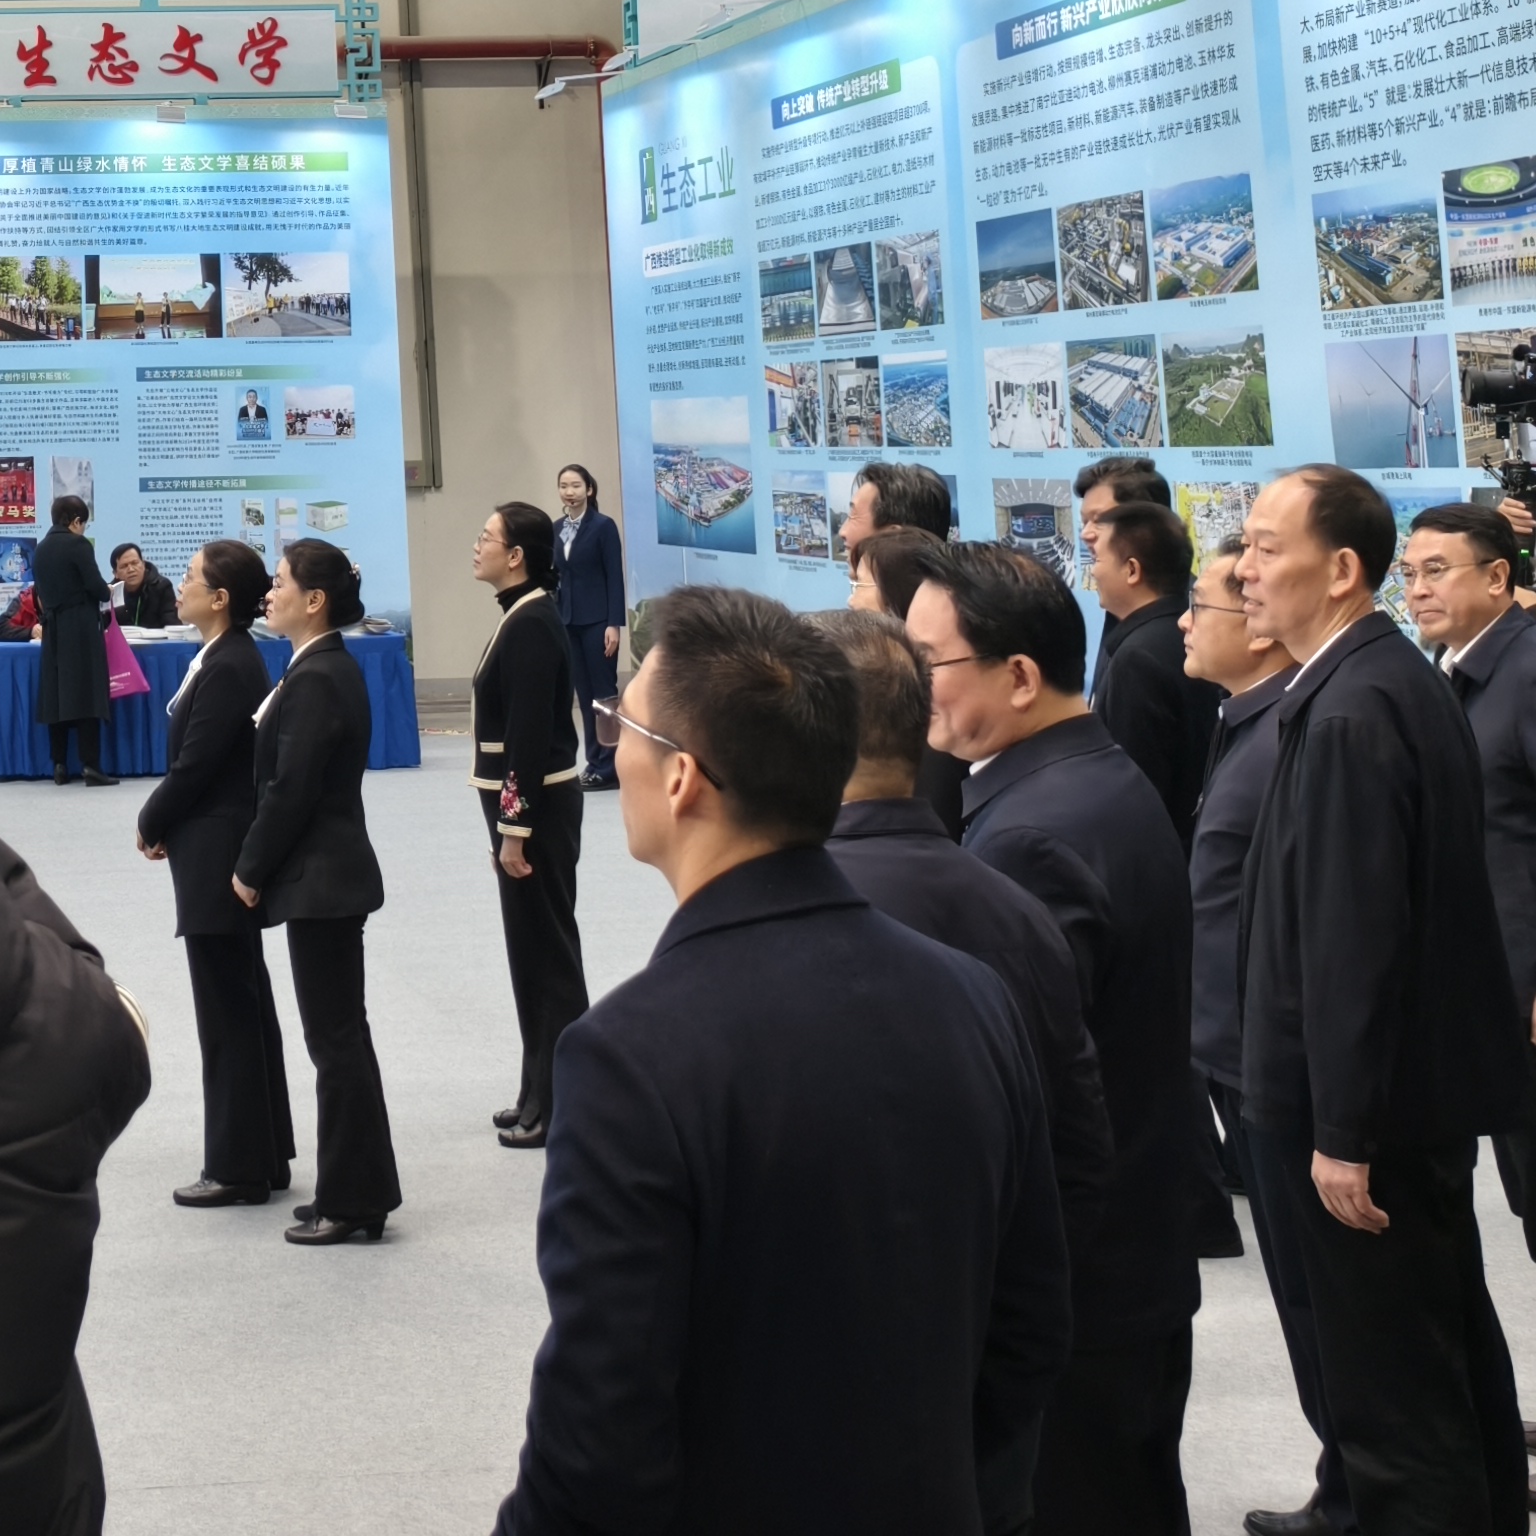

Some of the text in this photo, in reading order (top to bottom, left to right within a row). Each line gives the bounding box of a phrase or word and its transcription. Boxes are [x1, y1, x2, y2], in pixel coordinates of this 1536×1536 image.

[1011, 10, 1059, 50] 向新而行
[16, 16, 289, 87] 生态文学
[781, 69, 889, 122] 向上突破 传统产业转型升级
[2, 154, 306, 174] 厚植青山绿水情怀 生态文学喜结硕果
[660, 145, 736, 213] 生态工业
[144, 368, 243, 379] 生态文学交流活动精彩纷呈
[147, 478, 247, 490] 生态文学传播途径不断拓展
